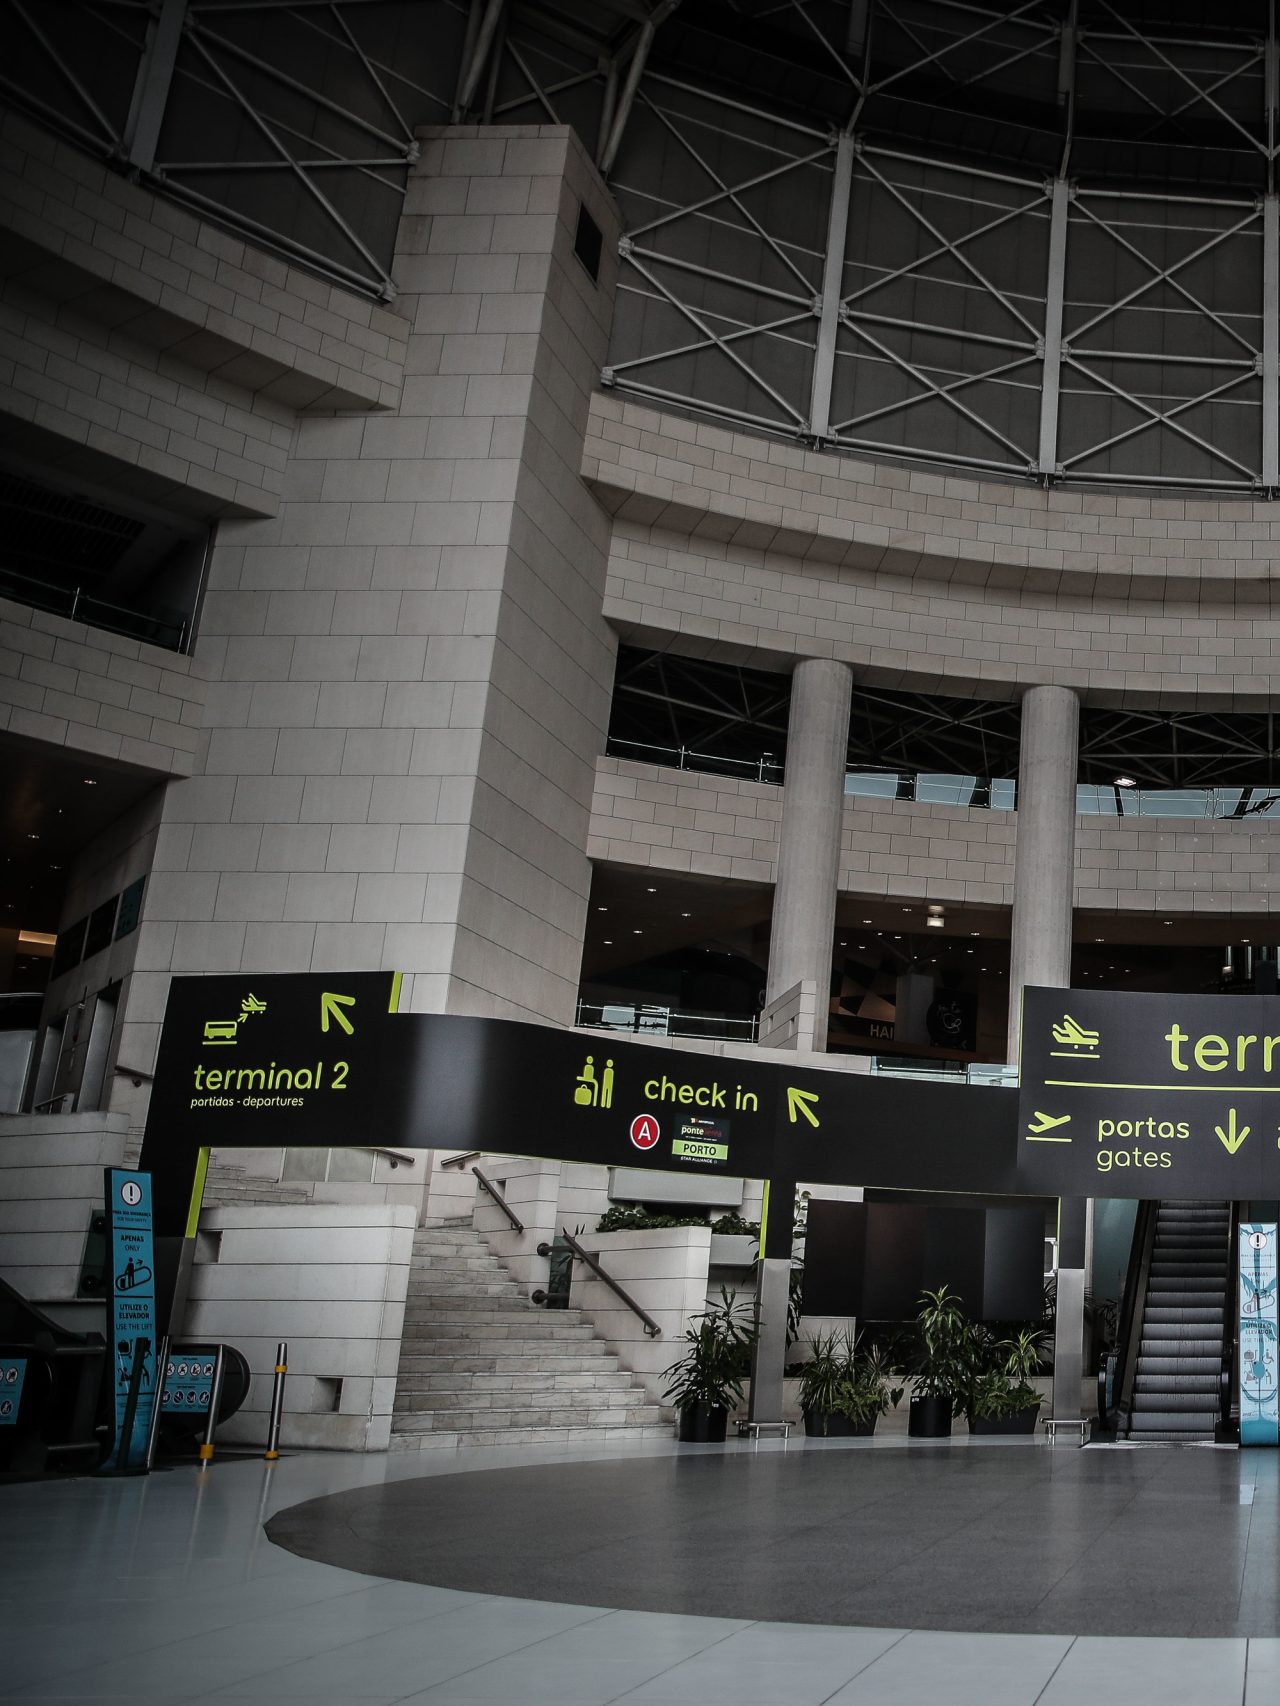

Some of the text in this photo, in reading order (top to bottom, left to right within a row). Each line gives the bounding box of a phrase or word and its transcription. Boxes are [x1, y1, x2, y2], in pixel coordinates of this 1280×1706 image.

[194, 1061, 350, 1090] terminal 2
[190, 1096, 234, 1109] partidas
[242, 1096, 304, 1109] departures
[644, 1075, 758, 1112] check in
[638, 1121, 652, 1141] A
[1098, 1117, 1190, 1142] portas
[683, 1143, 717, 1156] PORTO
[1096, 1147, 1172, 1172] gates
[120, 1234, 145, 1243] APENAS
[128, 1323, 140, 1331] THE
[141, 1323, 153, 1331] LIFT
